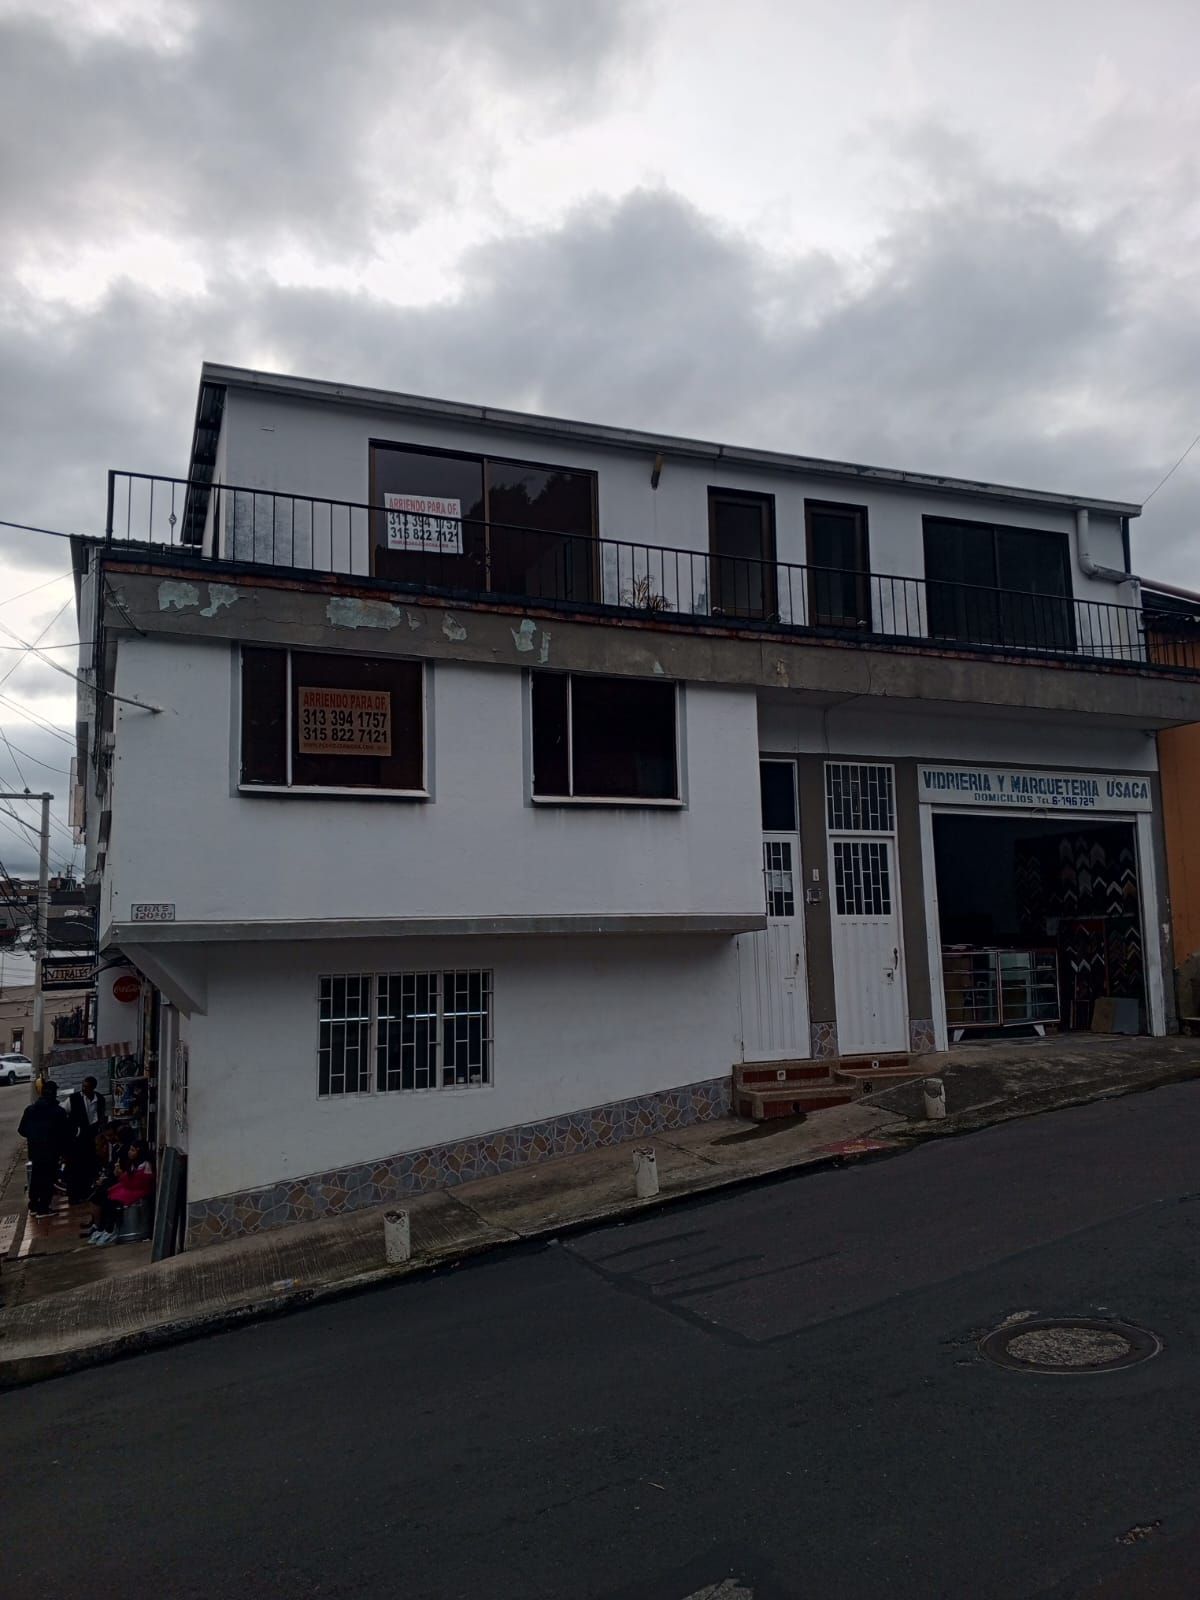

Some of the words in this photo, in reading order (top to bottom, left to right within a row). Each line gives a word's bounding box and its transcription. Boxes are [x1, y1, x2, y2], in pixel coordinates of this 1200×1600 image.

[389, 498, 426, 512] ARRIENDO
[427, 501, 446, 514] PARA
[390, 527, 410, 539] 315
[413, 529, 432, 541] 822
[304, 692, 348, 708] ARRIENDO
[350, 694, 373, 709] PARA
[303, 708, 326, 725] 313
[331, 710, 354, 727] 394
[358, 711, 387, 728] 1757
[304, 727, 327, 741] 315
[331, 728, 354, 742] 822
[358, 729, 387, 743] 7121
[923, 771, 991, 792] VIDRIERIA
[997, 775, 1005, 792] Y
[1010, 775, 1100, 797] MARQUETERIA
[1106, 780, 1148, 799] USACA
[974, 793, 1034, 804] DOMICILIOS
